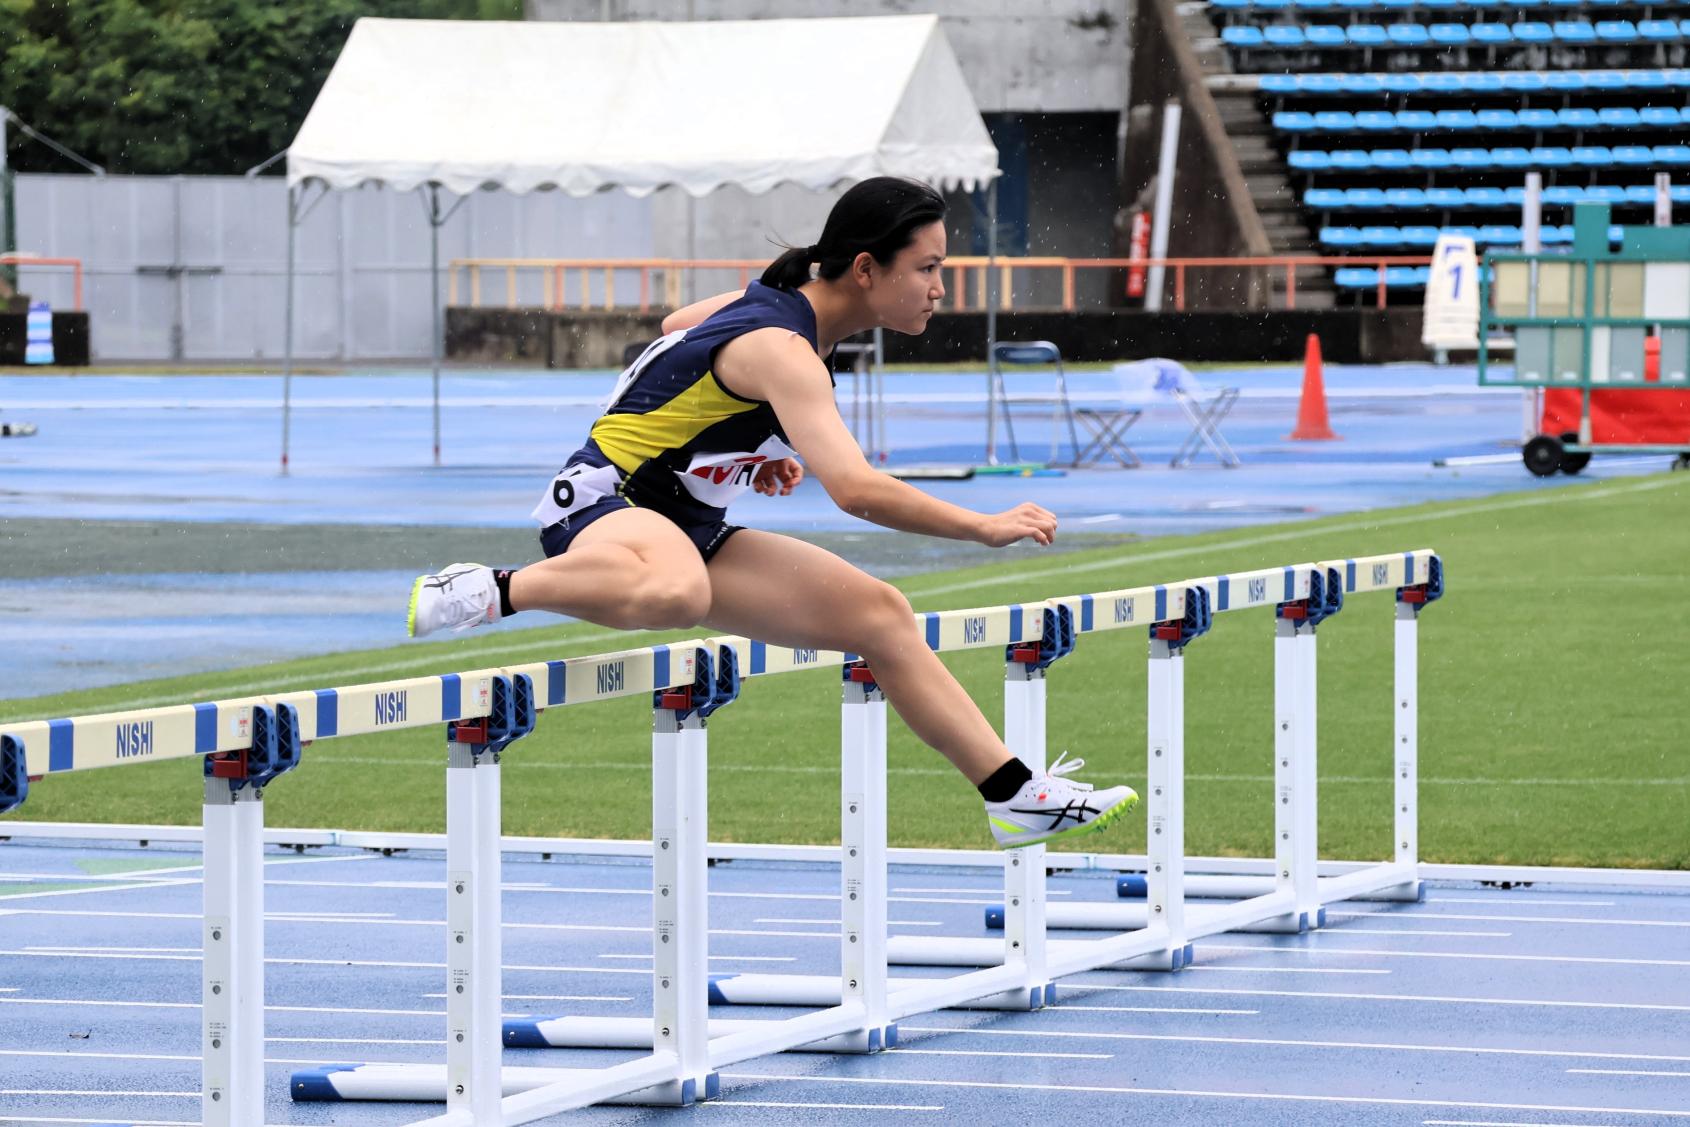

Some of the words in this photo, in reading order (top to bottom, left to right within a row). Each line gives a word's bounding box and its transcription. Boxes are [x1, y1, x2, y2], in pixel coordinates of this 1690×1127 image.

[1373, 564, 1388, 586] NISHI
[1249, 578, 1266, 602] NISHI
[1114, 599, 1134, 622] NISHI
[964, 617, 985, 644] NISHI
[597, 661, 624, 694] NISHI
[375, 691, 406, 726] NISHI
[116, 721, 153, 759] NISHI
